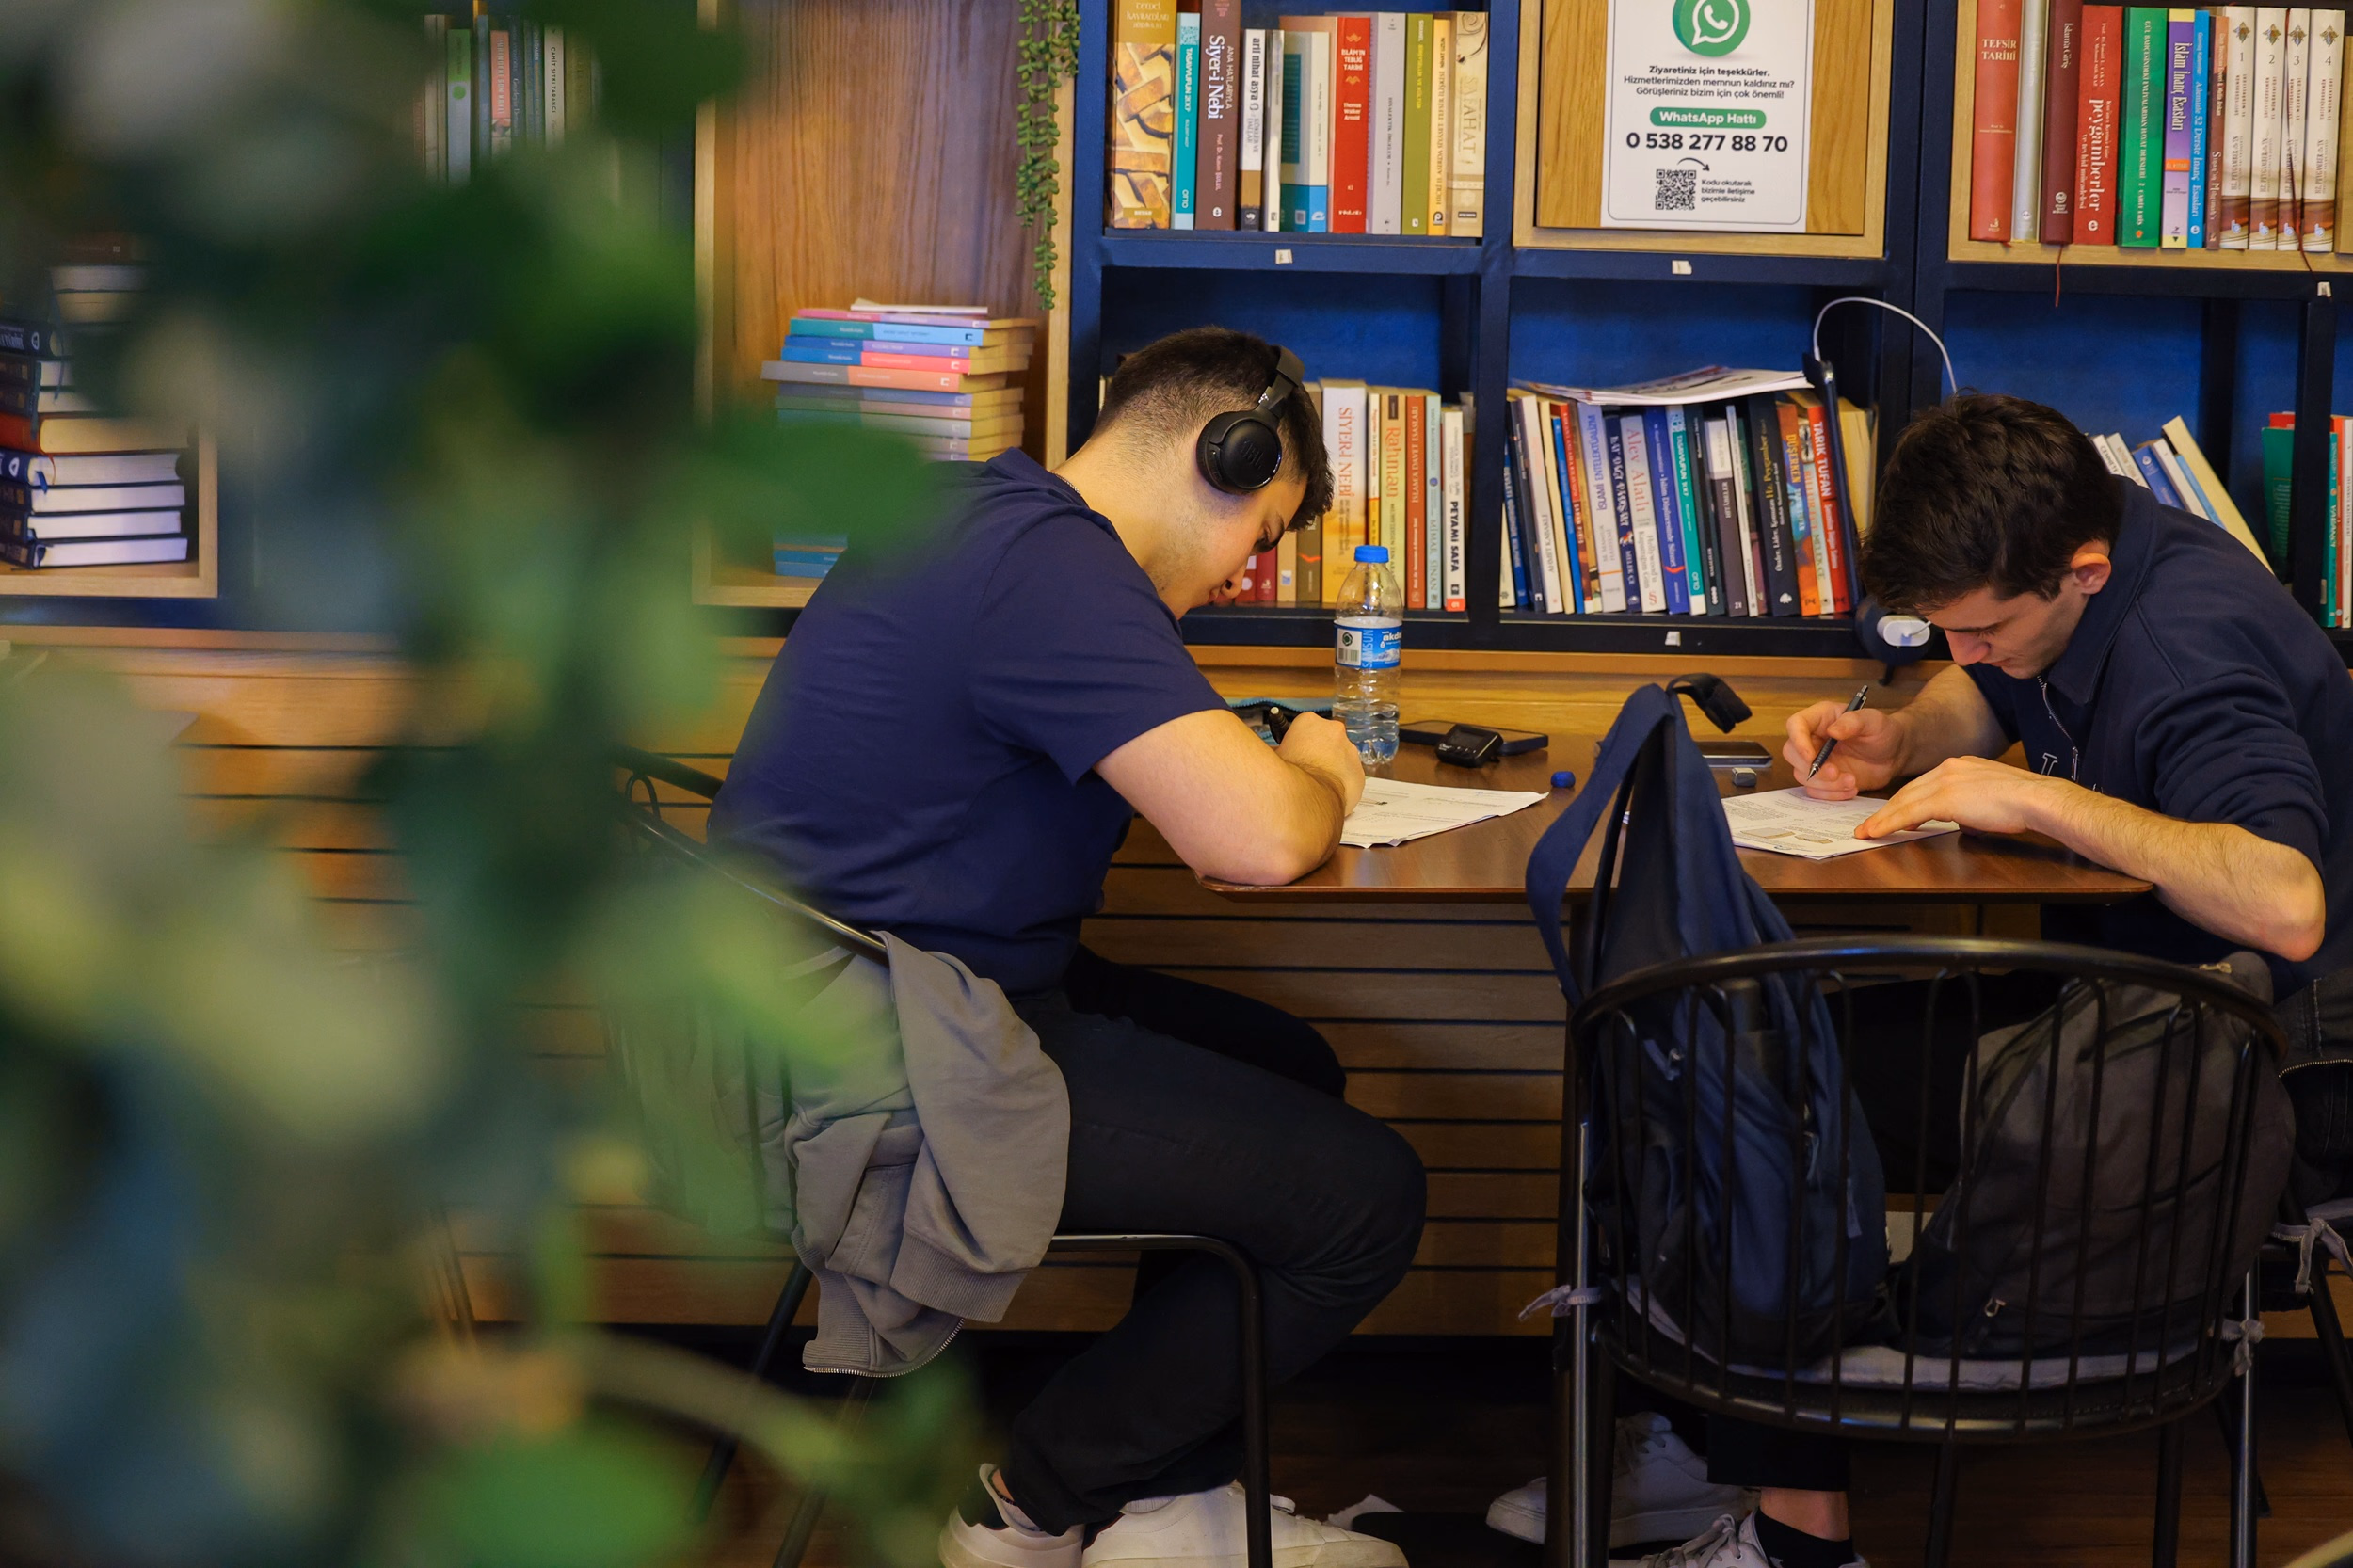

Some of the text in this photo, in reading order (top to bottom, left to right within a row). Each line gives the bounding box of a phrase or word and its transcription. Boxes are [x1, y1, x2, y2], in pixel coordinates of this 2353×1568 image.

[1982, 38, 2016, 49] TEFSİR
[1982, 51, 2015, 60] TARİHİ
[1252, 56, 1260, 78] nihat
[2142, 35, 2151, 80] BAHÇESİNDEKİ
[2239, 52, 2245, 62] 1
[2267, 54, 2276, 65] 2
[2293, 55, 2300, 66] 3
[2324, 56, 2332, 67] 4
[1206, 35, 1225, 119] Siyer-i Nebi
[1624, 76, 1700, 86] Hizmetlerimizden
[1744, 79, 1777, 88] kaldınız
[1649, 66, 1769, 77] Ziyaretiniz için teşekkürler.
[1250, 81, 1259, 100] asya
[1636, 88, 1784, 99] Görüşleriniz bizim için çok önemli!
[2171, 42, 2193, 130] İslâm İnanç Esasları
[1462, 75, 1476, 154] SAFAHAT
[2141, 81, 2151, 127] EVLİYALARDAN
[1659, 111, 1756, 125] WhatsApp Hattı
[2195, 116, 2202, 125] 52
[1626, 132, 1787, 152] 0 538 277 88 70
[2194, 128, 2202, 155] Derste
[2089, 99, 2105, 211] peygamberler
[2192, 157, 2203, 180] İnanç
[1181, 190, 1190, 208] OTTO
[2192, 185, 2201, 217] Esasları
[1338, 408, 1354, 457] SİYER-İ
[1385, 427, 1401, 498] Rahman
[1625, 428, 1650, 512] Alev Alatlı
[1676, 435, 1688, 479] TASAVVUFUN
[1760, 435, 1772, 481] Peygamber
[1785, 434, 1801, 483] DÜŞERKEN
[1813, 422, 1832, 496] TARIK TUFAN
[1450, 501, 1459, 572] PEYAMİ SAFA
[1429, 520, 1439, 590] MİMAR SİNAN
[1545, 548, 1555, 573] AHMET
[1666, 543, 1677, 567] Sünnet
[1362, 629, 1374, 667] SAMSUN
